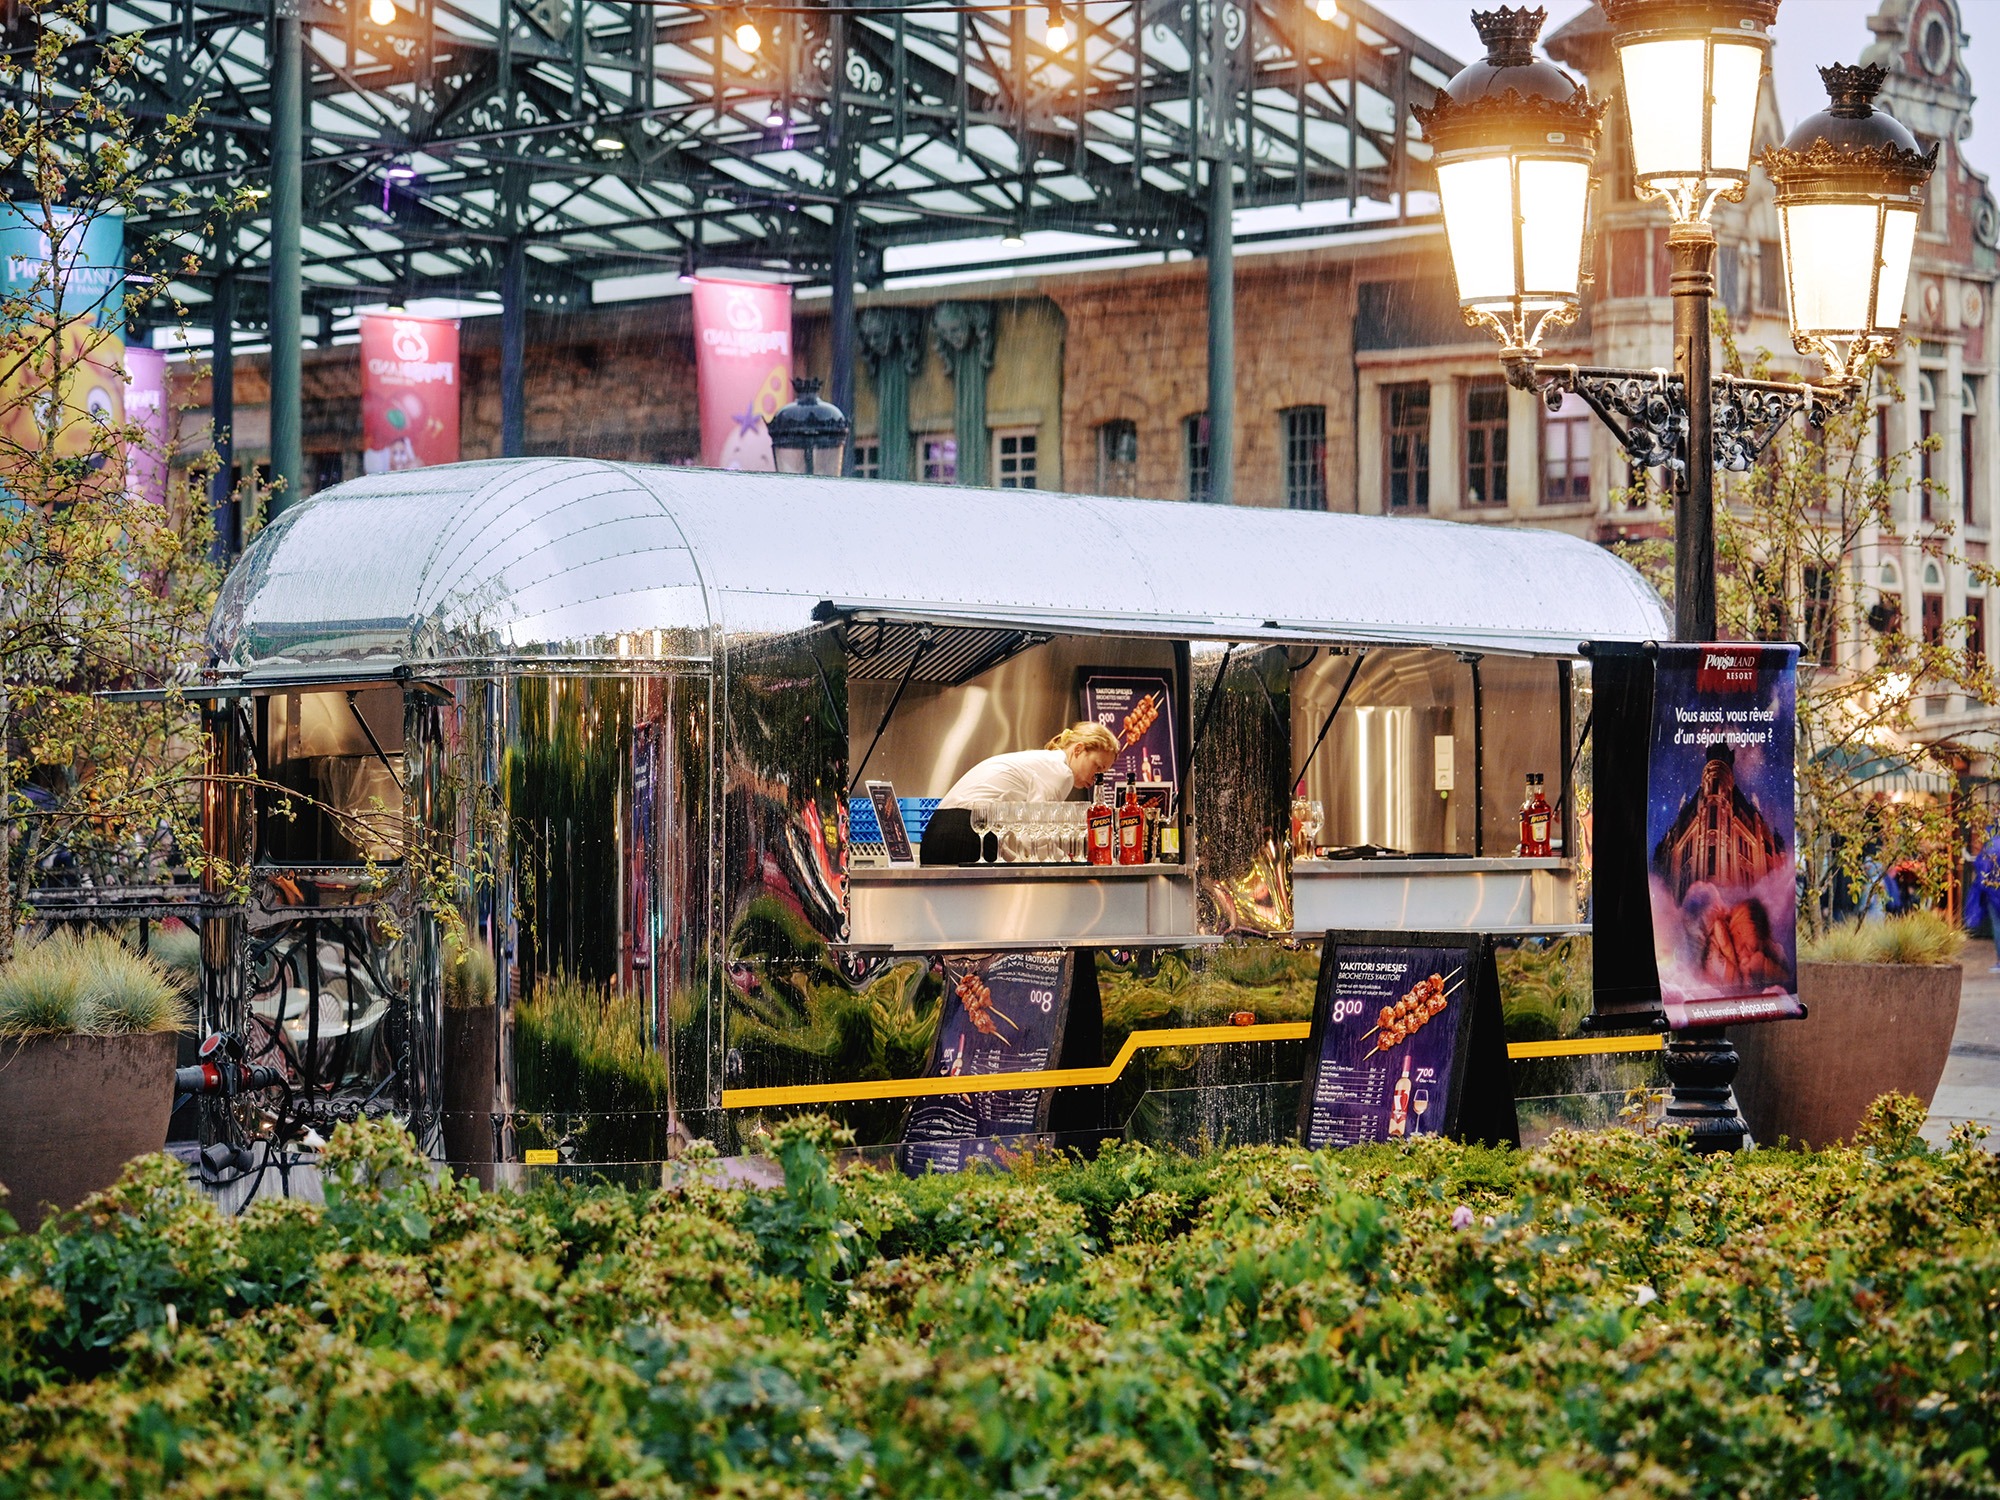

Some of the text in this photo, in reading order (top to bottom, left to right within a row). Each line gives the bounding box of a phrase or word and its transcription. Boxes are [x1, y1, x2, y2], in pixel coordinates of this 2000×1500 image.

[1726, 672, 1753, 680] RESORT
[1675, 707, 1774, 723] Vous aussi, vous rêvez
[1696, 728, 1725, 748] séjour
[1726, 728, 1766, 748] magique
[1339, 962, 1408, 974] YAKITORI SPIESJES
[1337, 972, 1401, 981] BROCHETTES YAKITORI
[1691, 1008, 1704, 1018] info
[1739, 1002, 1777, 1018] plopsa.com
